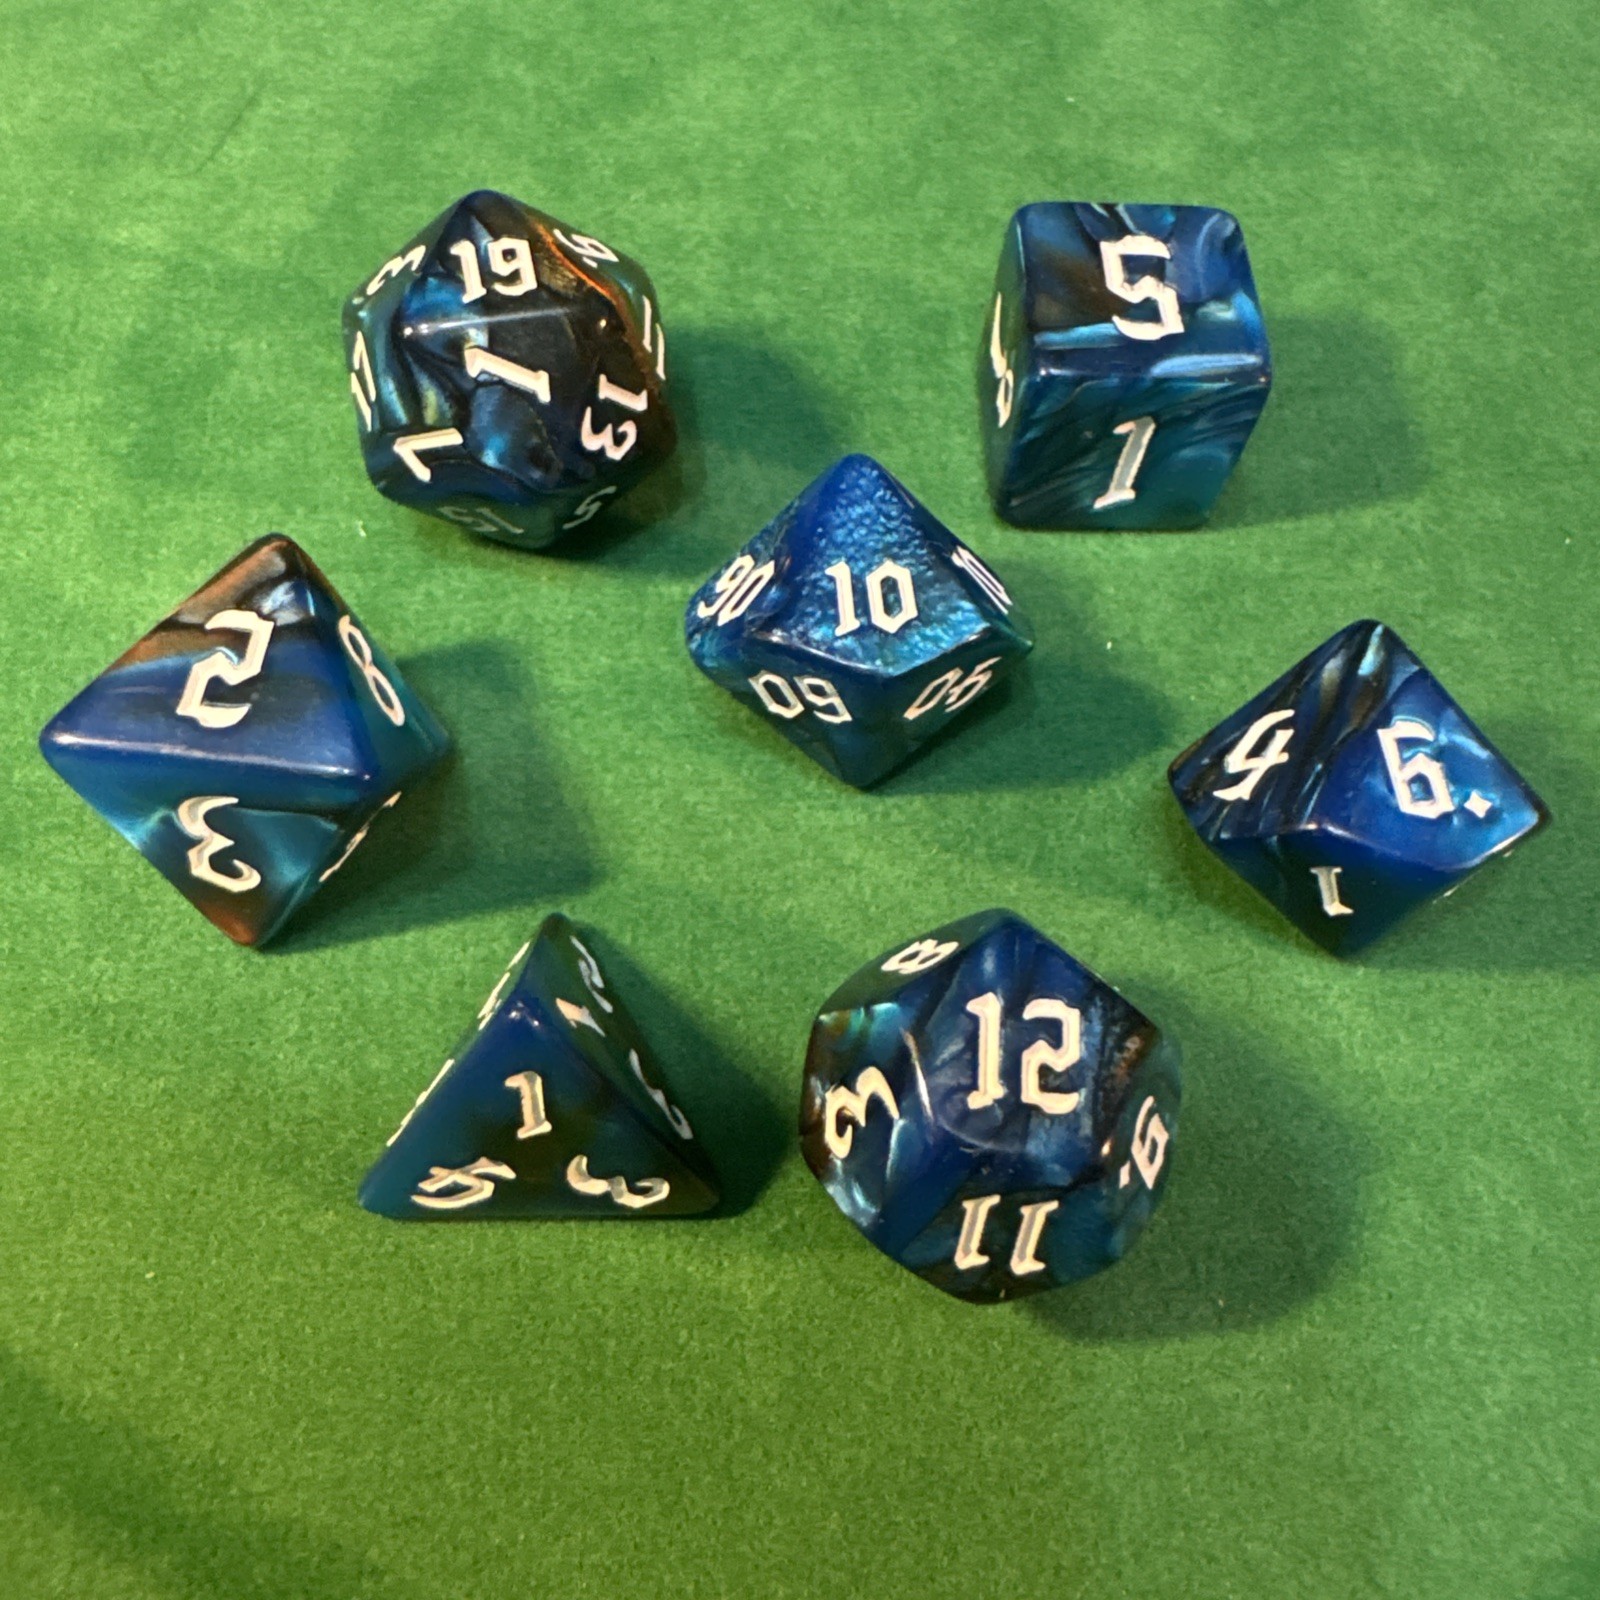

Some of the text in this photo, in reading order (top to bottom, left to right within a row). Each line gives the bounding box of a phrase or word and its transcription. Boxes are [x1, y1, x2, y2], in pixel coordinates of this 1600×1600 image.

[364, 244, 428, 297] 3
[450, 236, 540, 305] 19
[1098, 233, 1186, 342] 5
[463, 344, 553, 405] 1
[391, 426, 465, 484] 7
[579, 373, 650, 462] 13
[1092, 413, 1157, 510] 1
[696, 553, 776, 627] 90
[824, 558, 919, 637] 10
[174, 606, 277, 730] 2
[337, 614, 407, 728] 8
[1211, 708, 1296, 802] 4
[175, 795, 263, 894] 3
[1308, 864, 1356, 919] 1
[880, 937, 960, 975] 8
[964, 991, 1084, 1115] 12
[503, 1070, 553, 1141] 1
[823, 1065, 901, 1160] 3
[410, 1156, 517, 1210] 4
[565, 1154, 671, 1210] 3
[953, 1193, 1060, 1277] 11
